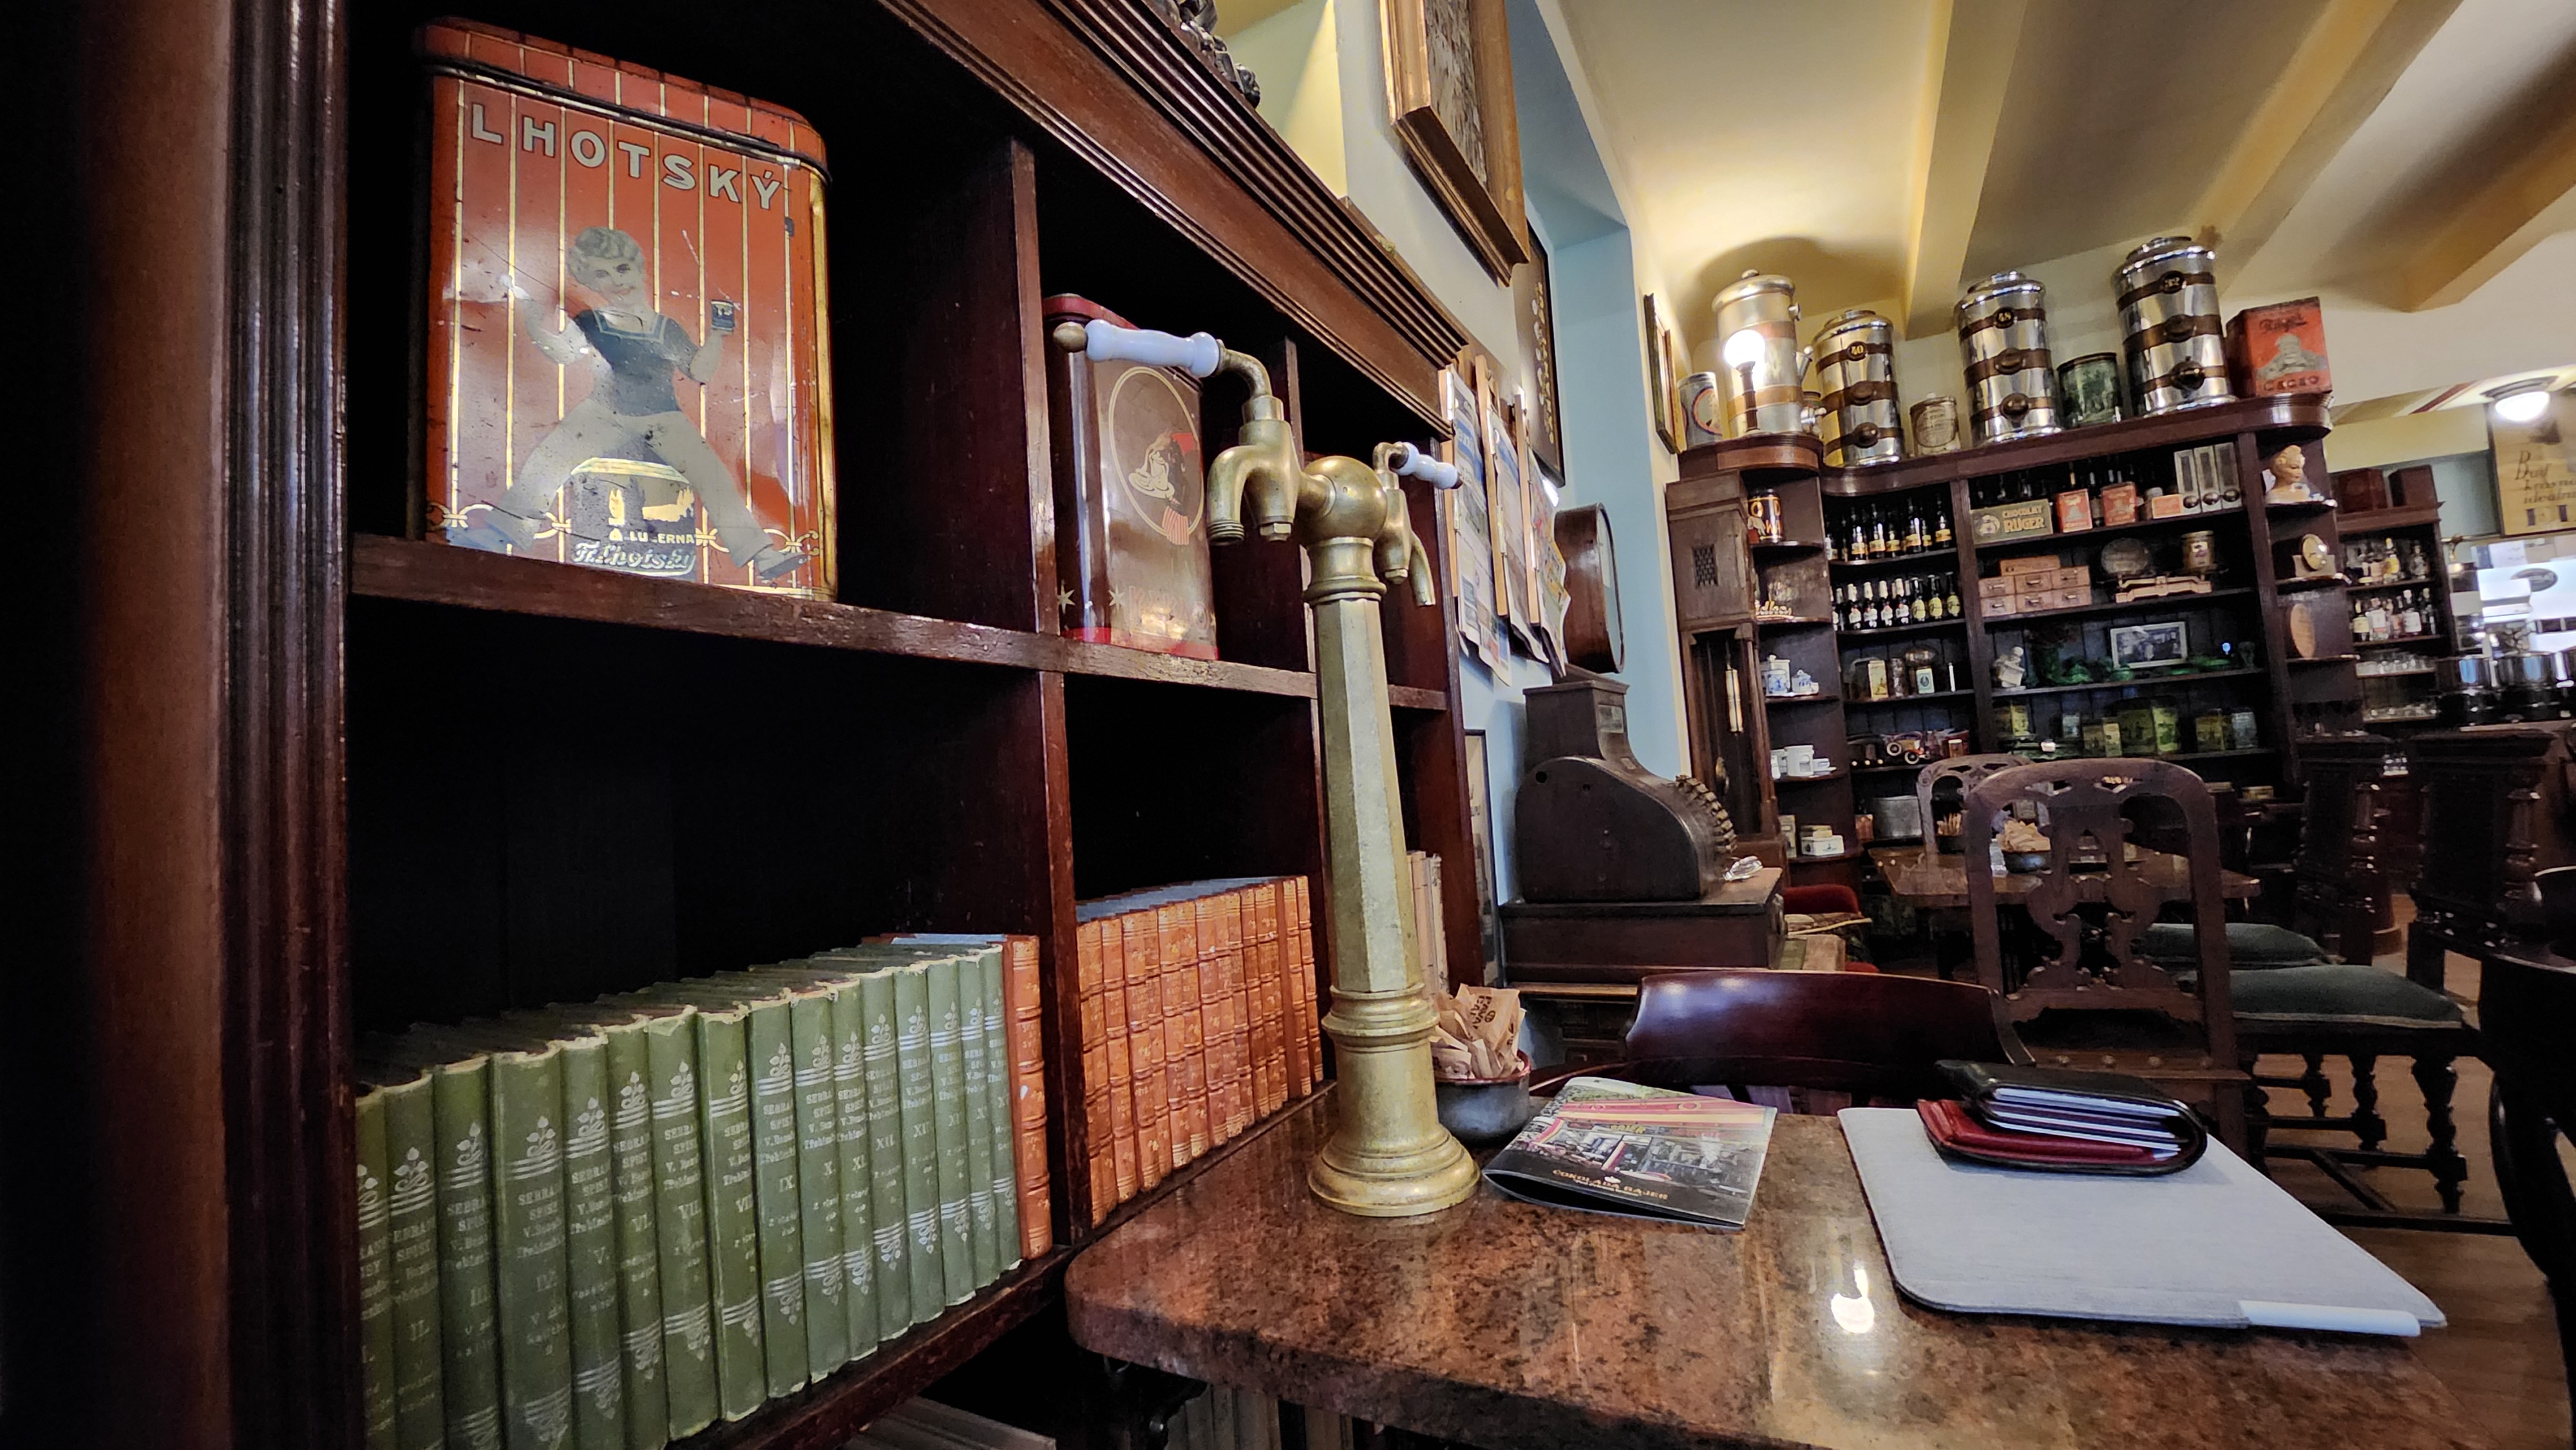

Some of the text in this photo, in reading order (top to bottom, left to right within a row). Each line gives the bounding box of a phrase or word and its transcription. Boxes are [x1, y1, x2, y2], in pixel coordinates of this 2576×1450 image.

[471, 103, 784, 210] LHOTSKÝ
[2002, 505, 2043, 518] CHOCOLAT
[629, 531, 695, 544] LUERNA
